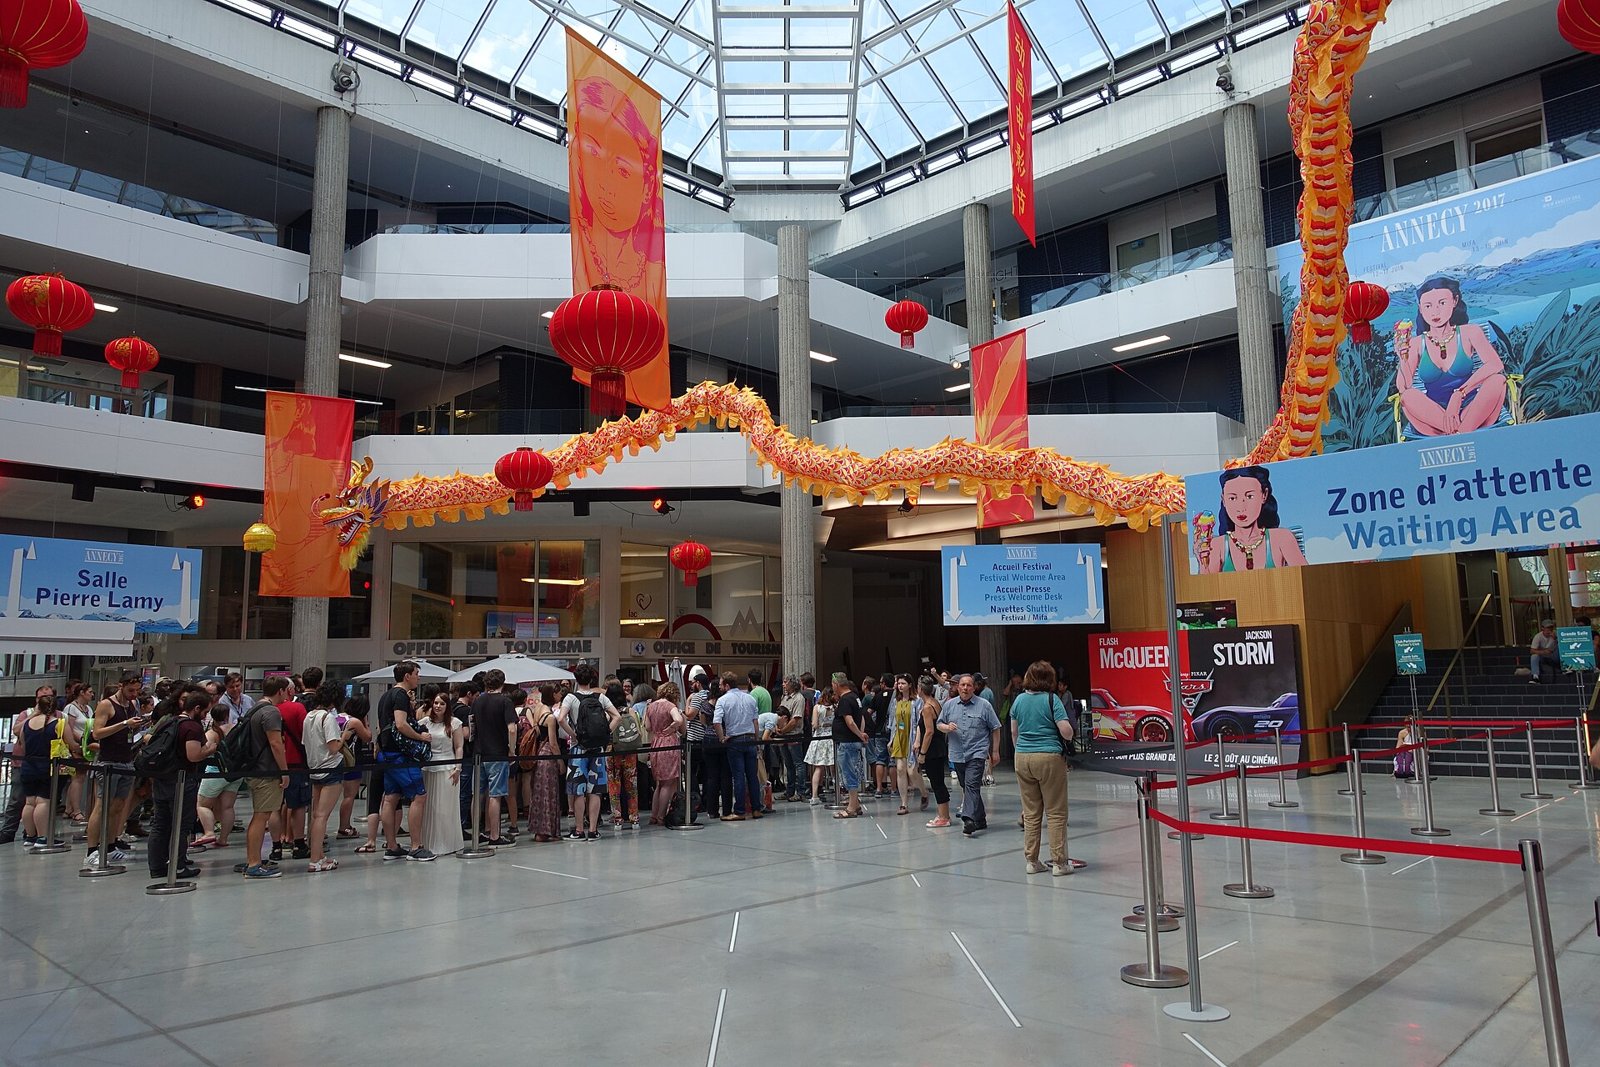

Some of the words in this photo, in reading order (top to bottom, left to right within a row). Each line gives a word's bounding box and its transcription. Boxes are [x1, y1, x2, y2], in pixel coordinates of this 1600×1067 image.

[1381, 204, 1469, 253] ANNECY
[1473, 192, 1507, 215] 2017
[1419, 446, 1467, 466] ANNECY
[1327, 486, 1405, 516] Zone
[1343, 514, 1477, 550] Waiting
[1491, 505, 1582, 537] Area
[86, 550, 117, 562] ANNECY
[992, 563, 1020, 571] Accueil
[1022, 562, 1052, 570] Festival
[77, 569, 128, 588] Salle
[979, 574, 1009, 582] Festival
[1011, 573, 1046, 581] Welcome
[1048, 573, 1066, 581] Area
[1025, 585, 1051, 593] Presse
[35, 587, 101, 607] Pierre
[108, 590, 164, 612] Lamy
[984, 594, 1006, 602] Press
[1007, 593, 1043, 601] Welcome
[1044, 592, 1063, 600] Desk
[990, 605, 1025, 613] Navettes
[1026, 605, 1058, 613] Shuttles
[1245, 630, 1272, 640] JACKSON
[1099, 637, 1119, 646] FLASH
[393, 642, 450, 656] OFFICE
[466, 641, 488, 655] DE
[504, 640, 592, 655] TOURISME
[653, 641, 696, 655] OFFICE
[705, 642, 721, 655] DE
[731, 642, 783, 655] TOURISM
[1213, 641, 1274, 666] STORM
[1254, 720, 1284, 728] 20
[1145, 752, 1167, 761] GRAND
[1204, 754, 1213, 762] LE
[1224, 752, 1239, 763] OÛT
[1239, 754, 1251, 763] AU
[1251, 754, 1279, 765] CINÉMA
